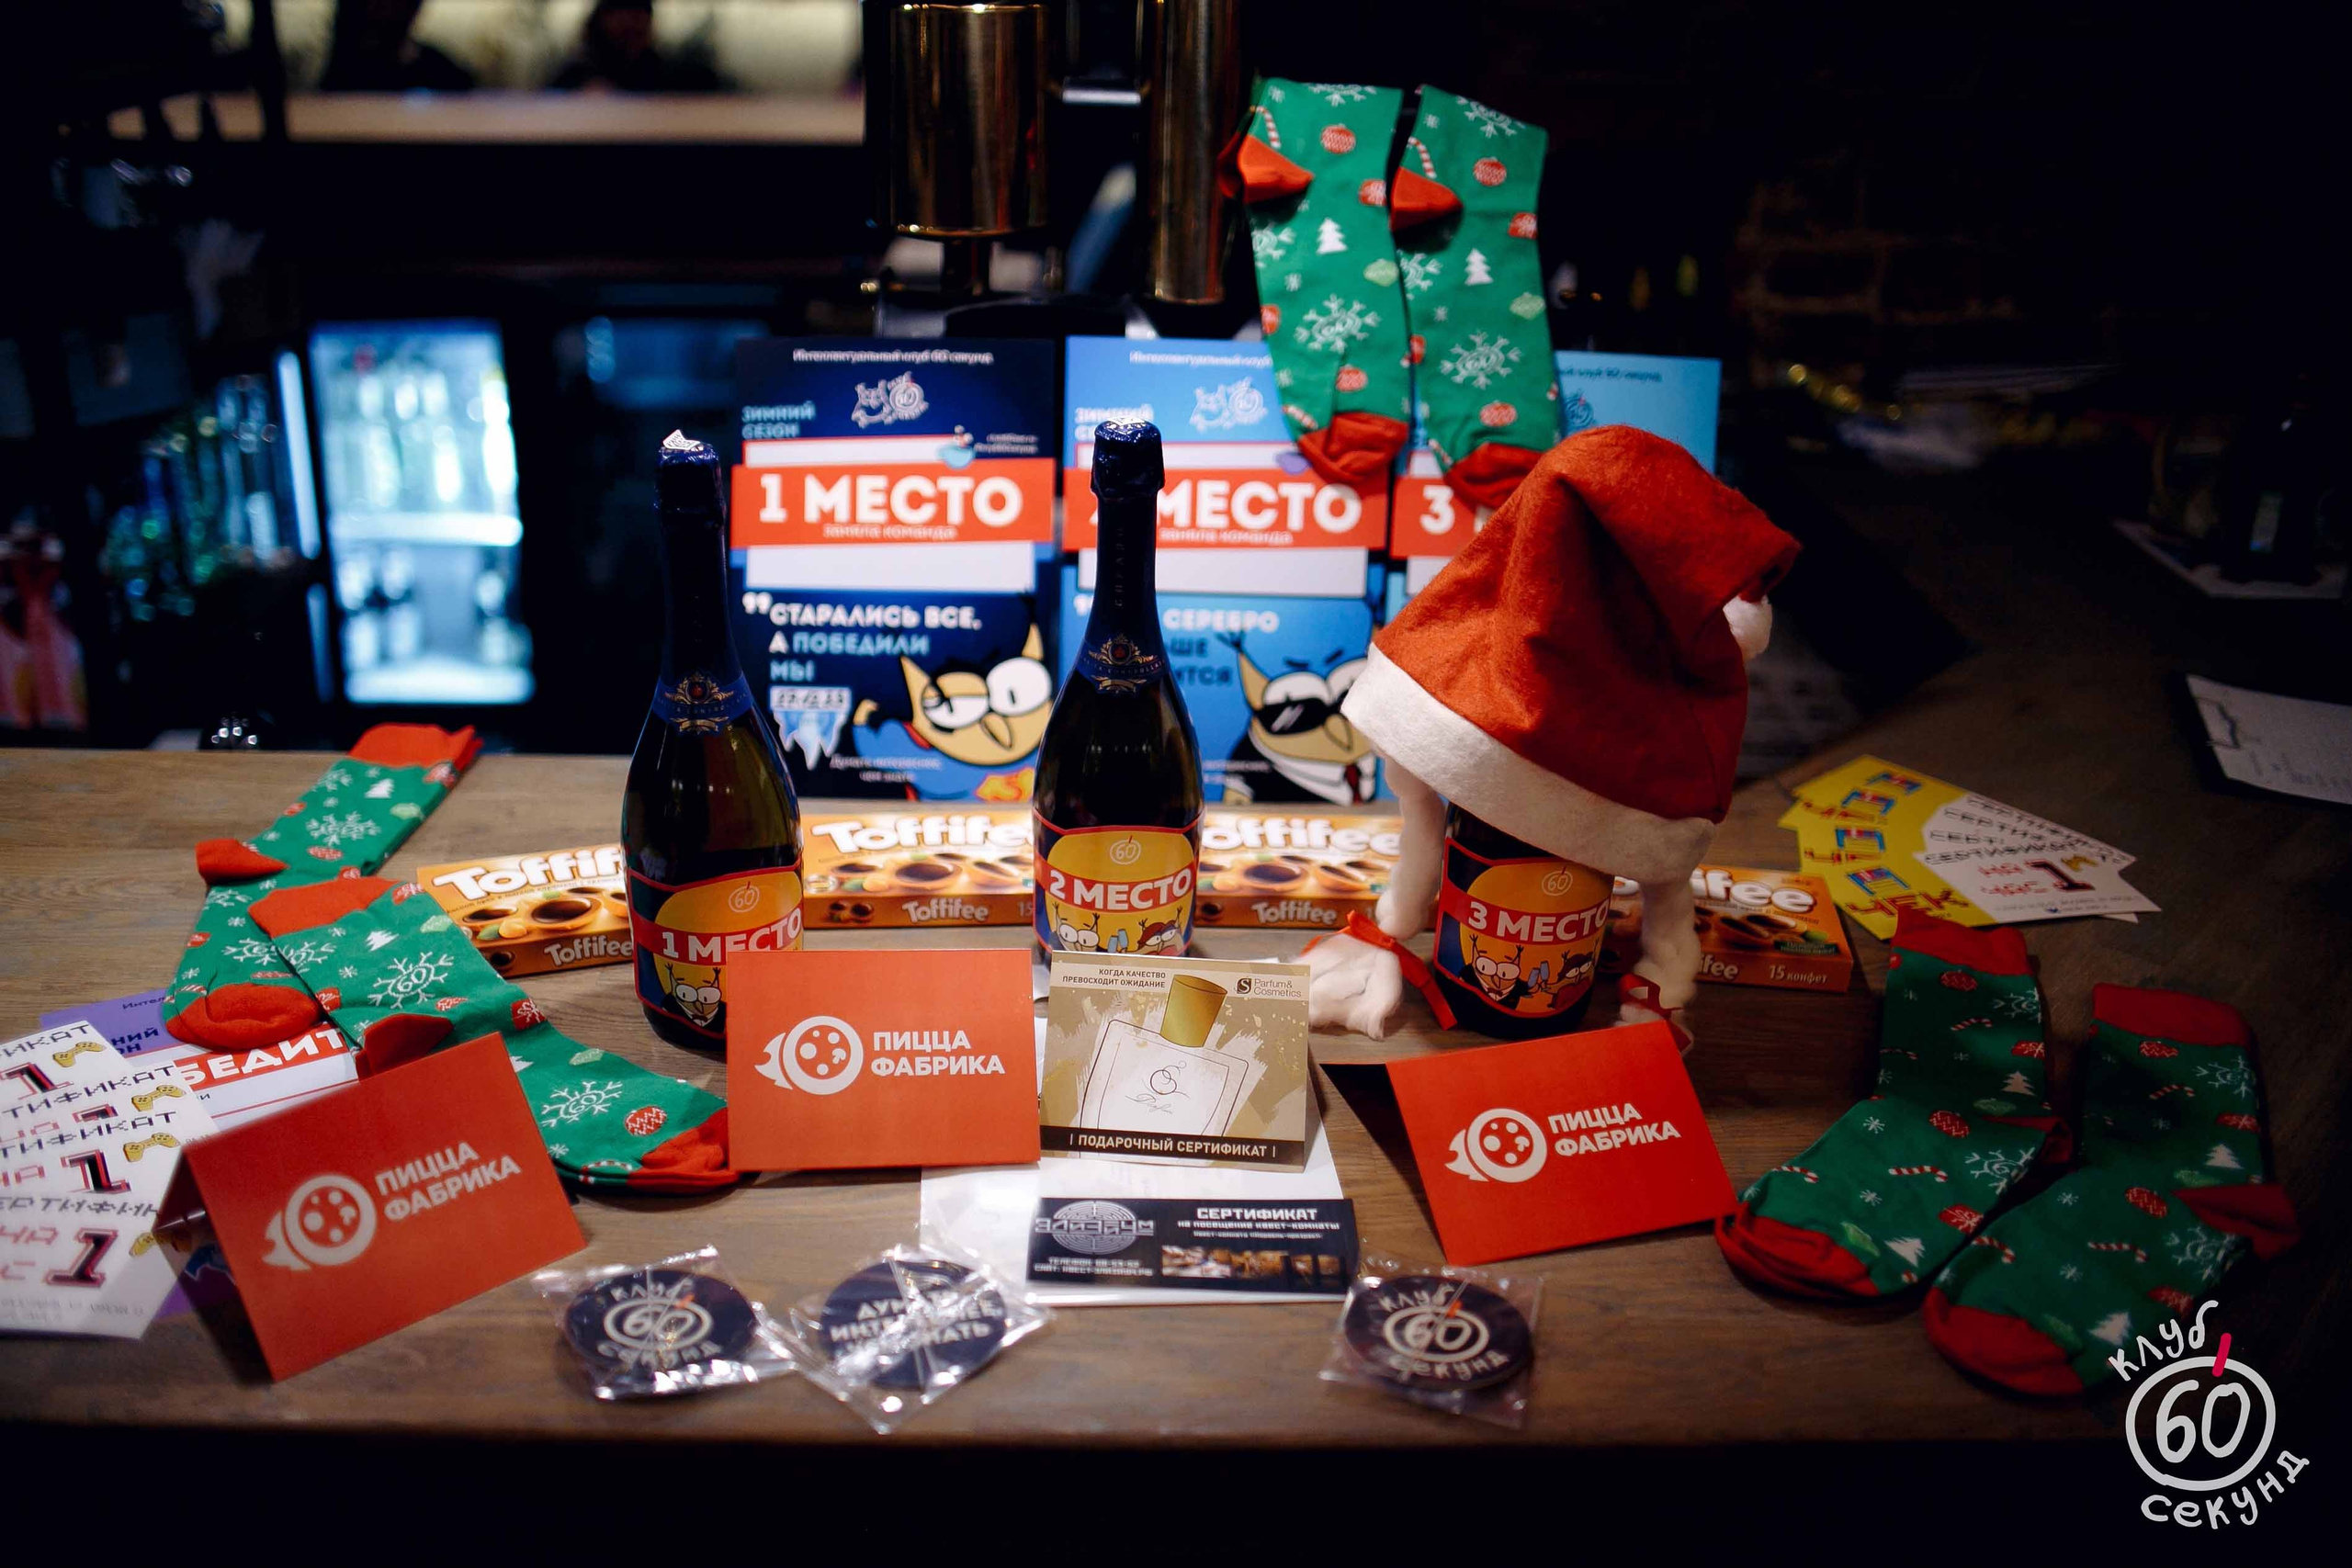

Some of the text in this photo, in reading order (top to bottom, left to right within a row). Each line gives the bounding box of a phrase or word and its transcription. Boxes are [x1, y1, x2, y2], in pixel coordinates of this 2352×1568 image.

[741, 400, 816, 423] ЗИМНИЙ
[741, 423, 800, 440] СЕЗОН
[759, 473, 1024, 528] 1 МЕСТО
[1419, 484, 1456, 536] 3
[1162, 607, 1280, 634] СЕРЕБРО
[768, 630, 931, 657] А ПОБЕДИЛИ
[769, 659, 816, 682] МЫ
[1115, 843, 1137, 861] 60
[1049, 868, 1193, 910] 2 МЕСТО
[1547, 874, 1568, 891] 60
[734, 888, 756, 906] 60
[901, 897, 989, 923] Toffifee
[1251, 900, 1337, 925] Toffifee
[1467, 898, 1610, 942] 3 МЕСТО
[662, 931, 679, 959] 1
[396, 967, 428, 994] 60
[1062, 976, 1166, 988] ПРЕВОСХОДИТ ОЖИДАНИЕ
[1099, 968, 1166, 979] КОГДА КАЧЕСТВО
[1769, 965, 1828, 985] 15 конфет
[1253, 986, 1302, 998] Cosmetics
[873, 1030, 972, 1054] ПИЦЦА
[871, 1055, 1005, 1077] ФАБРИКА
[1547, 1102, 1643, 1134] ПИЦЦА
[1078, 1134, 1267, 1157] ПОДАРОЧНЫЙ СЕРТИФИКАТ
[1555, 1121, 1681, 1156] ФАБРИКА
[60, 1148, 131, 1194] 1
[374, 1142, 481, 1196] ПИЦЦА
[384, 1155, 522, 1222] ФАБРИКА
[1196, 1207, 1317, 1221] СЕРТИФИКАТ
[46, 1227, 119, 1289] 1
[622, 1304, 697, 1341] 60
[1404, 1313, 1472, 1351] 60
